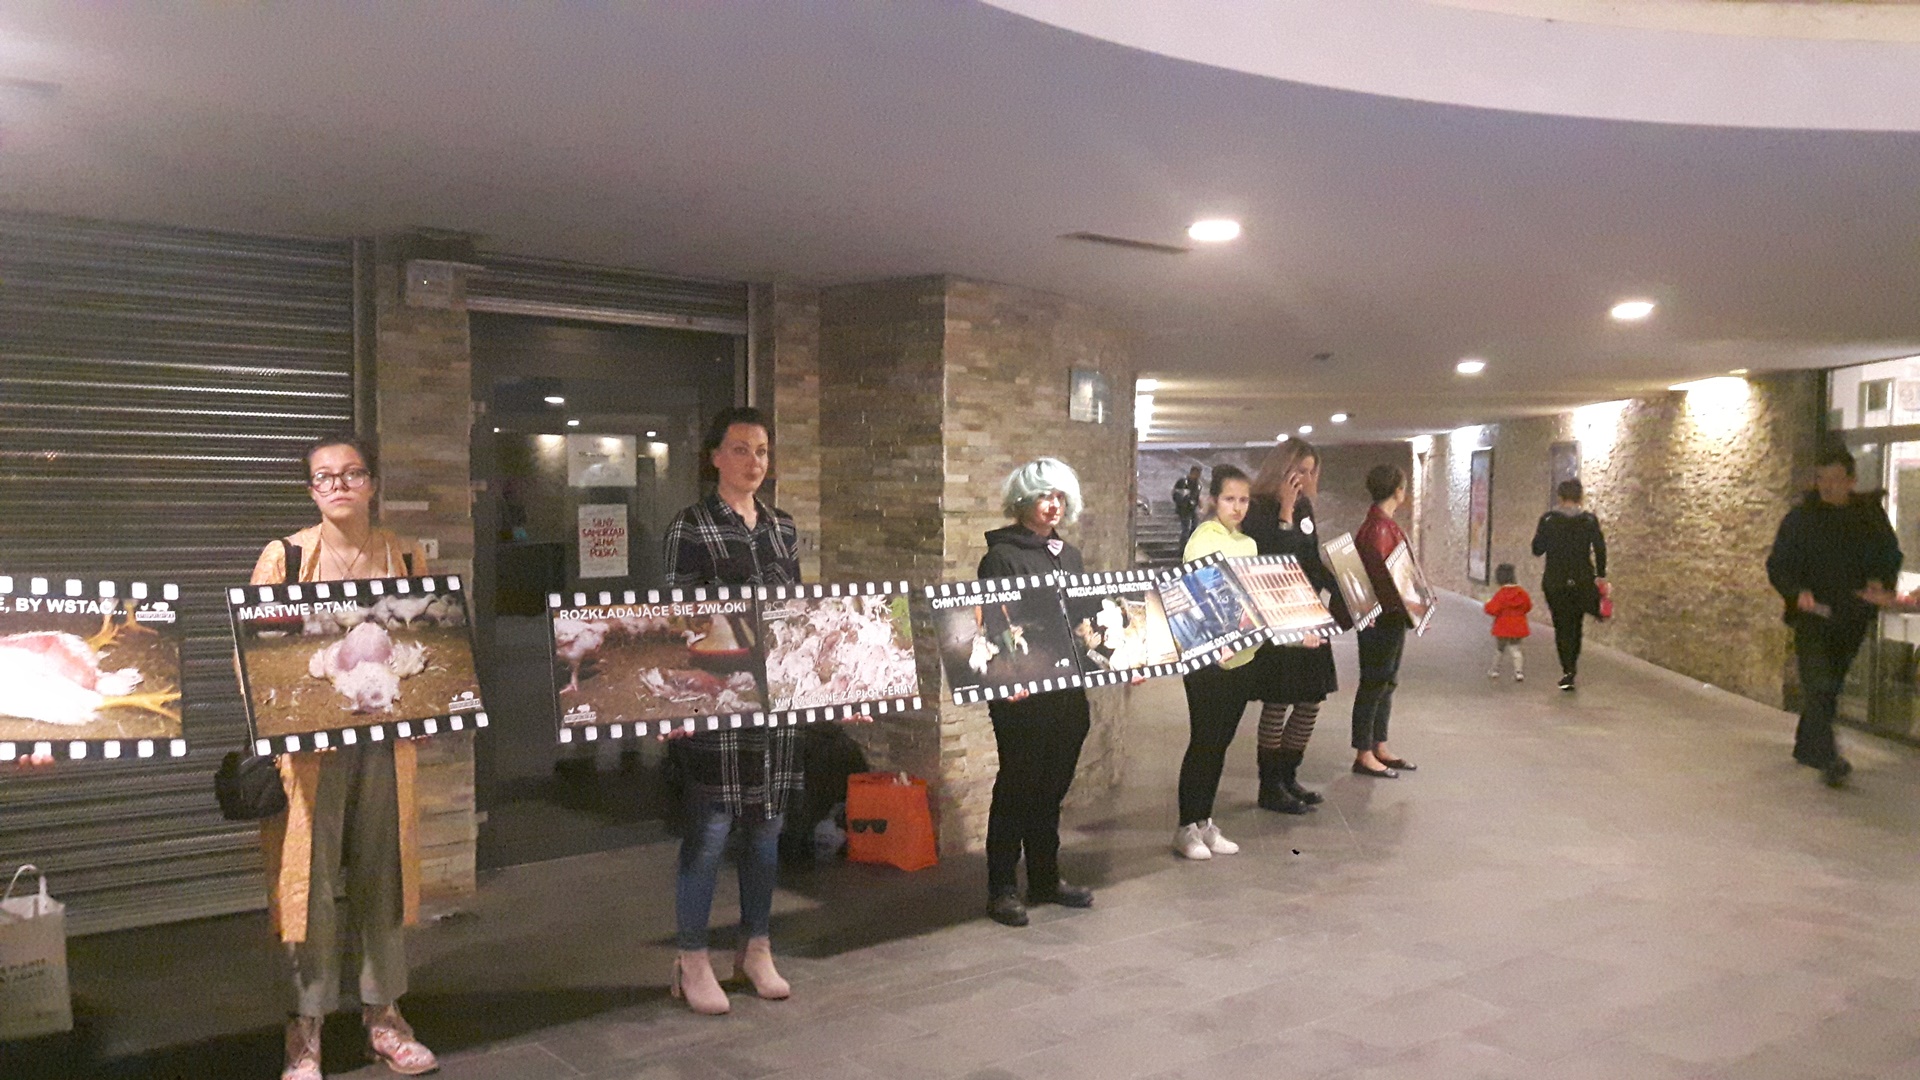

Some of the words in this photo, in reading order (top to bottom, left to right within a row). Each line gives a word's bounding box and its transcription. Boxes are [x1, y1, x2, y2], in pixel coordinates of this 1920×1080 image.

[1106, 584, 1118, 594] DO
[15, 597, 43, 612] BY
[932, 594, 985, 610] CHWYTANE
[984, 592, 998, 604] ZA
[997, 590, 1022, 603] NOGI
[239, 602, 311, 620] MARTWE
[313, 600, 358, 615] PTAKI
[559, 605, 670, 621] ROZKŁADAJĄCE
[672, 603, 694, 617] SIĘ
[696, 601, 747, 615] ZWŁOKI
[1213, 636, 1226, 648] DO
[882, 684, 914, 697] FERMY
